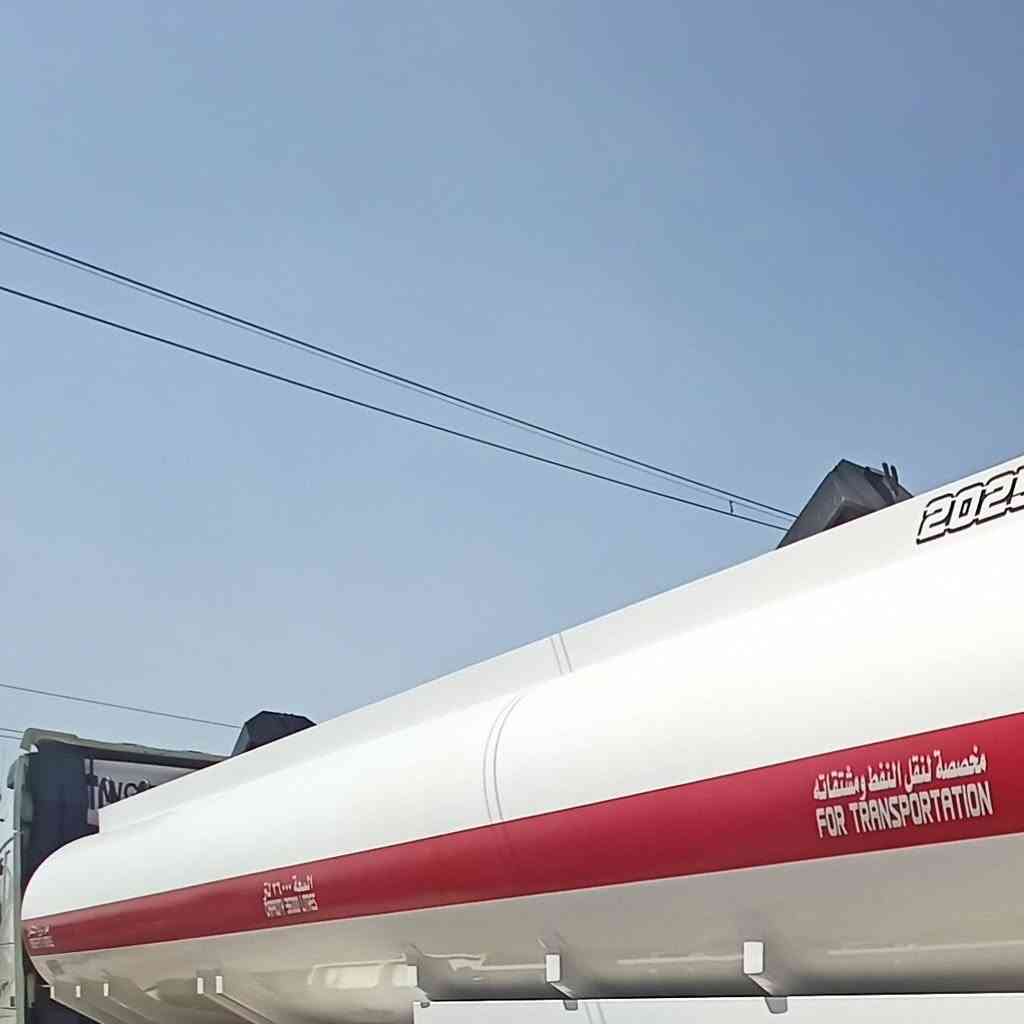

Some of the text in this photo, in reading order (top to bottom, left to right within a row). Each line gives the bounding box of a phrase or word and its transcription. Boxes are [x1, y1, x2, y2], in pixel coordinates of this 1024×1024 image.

[813, 744, 987, 800] مخصصة لنقل النفط ومشتقاته
[816, 781, 993, 838] FOR TRANSPORTATION
